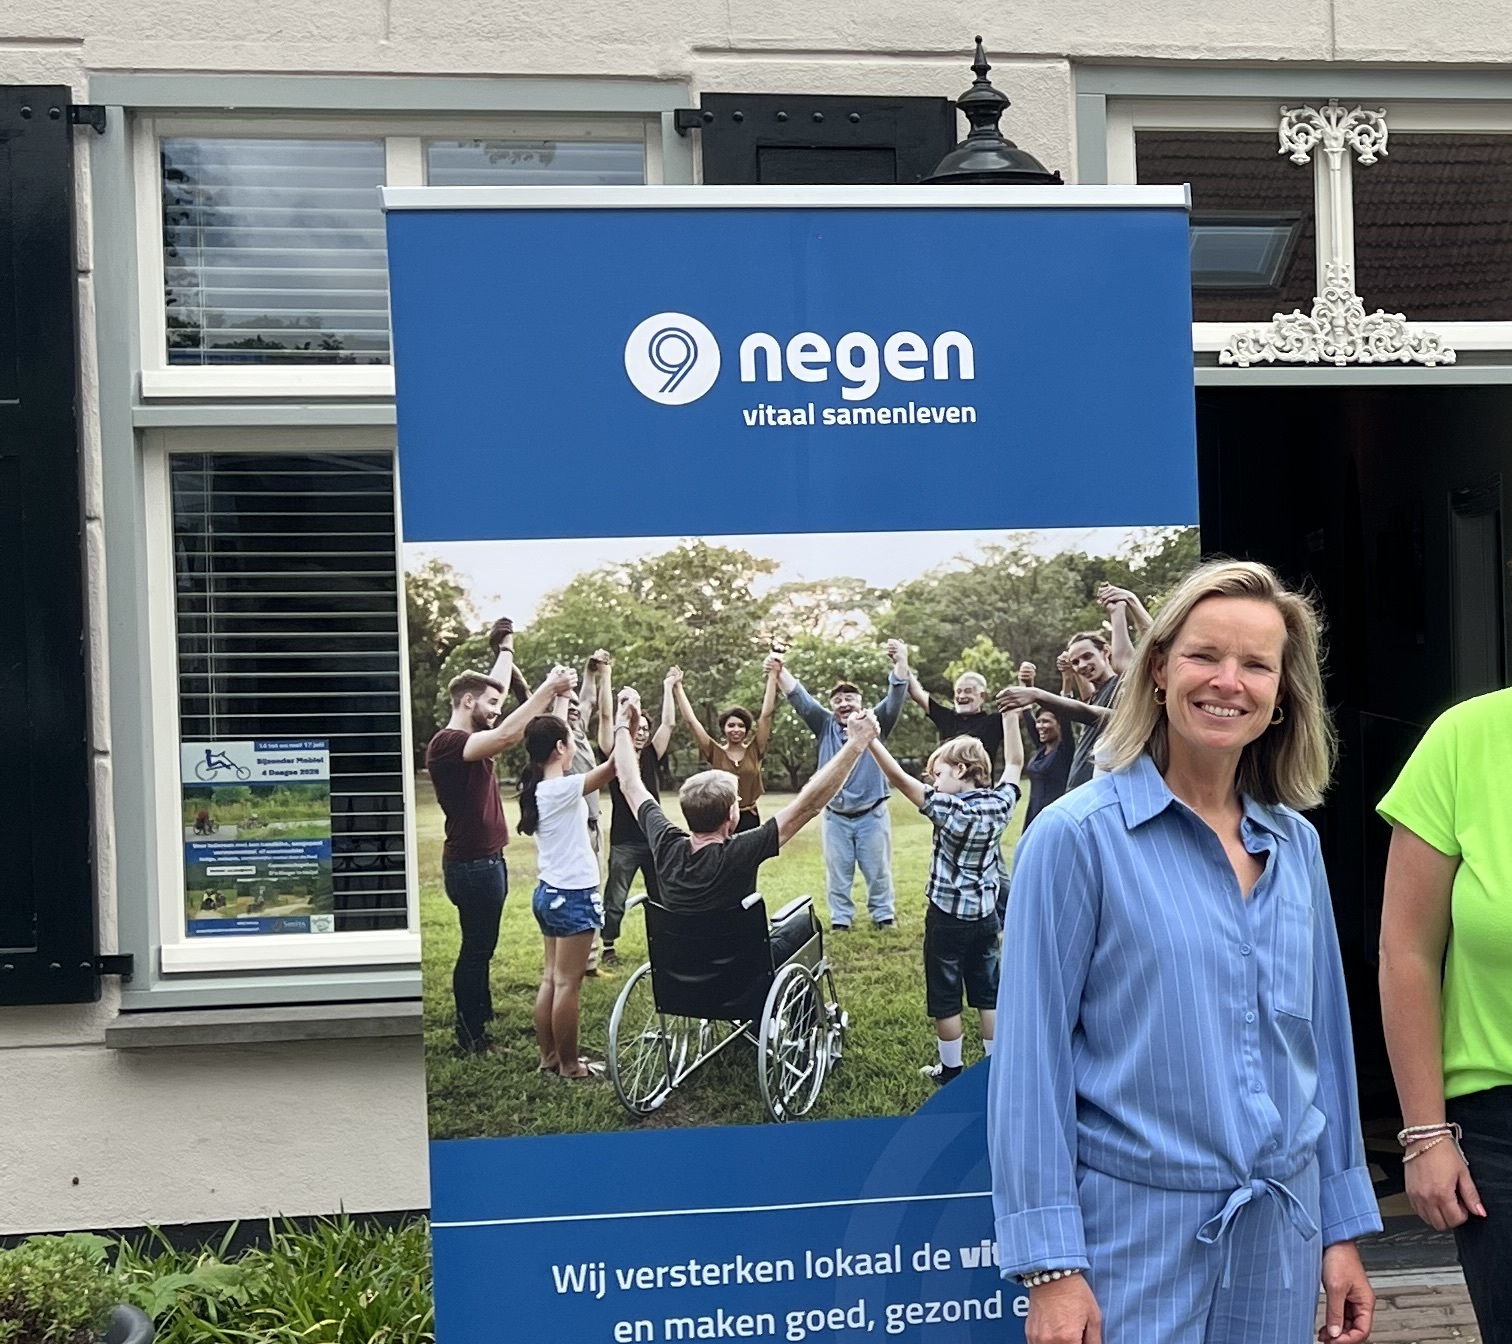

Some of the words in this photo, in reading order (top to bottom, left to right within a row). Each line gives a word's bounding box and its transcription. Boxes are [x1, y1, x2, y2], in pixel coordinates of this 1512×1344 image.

[739, 330, 975, 401] negen
[742, 402, 815, 426] vitaal
[822, 401, 977, 426] samenleven
[551, 1262, 606, 1299] Wij
[615, 1254, 795, 1290] versterken
[805, 1244, 901, 1279] lokaal
[912, 1242, 951, 1272] de
[614, 1320, 654, 1343] en
[664, 1308, 775, 1340] maken
[785, 1298, 875, 1341] goed,
[885, 1289, 1002, 1334] gezond
